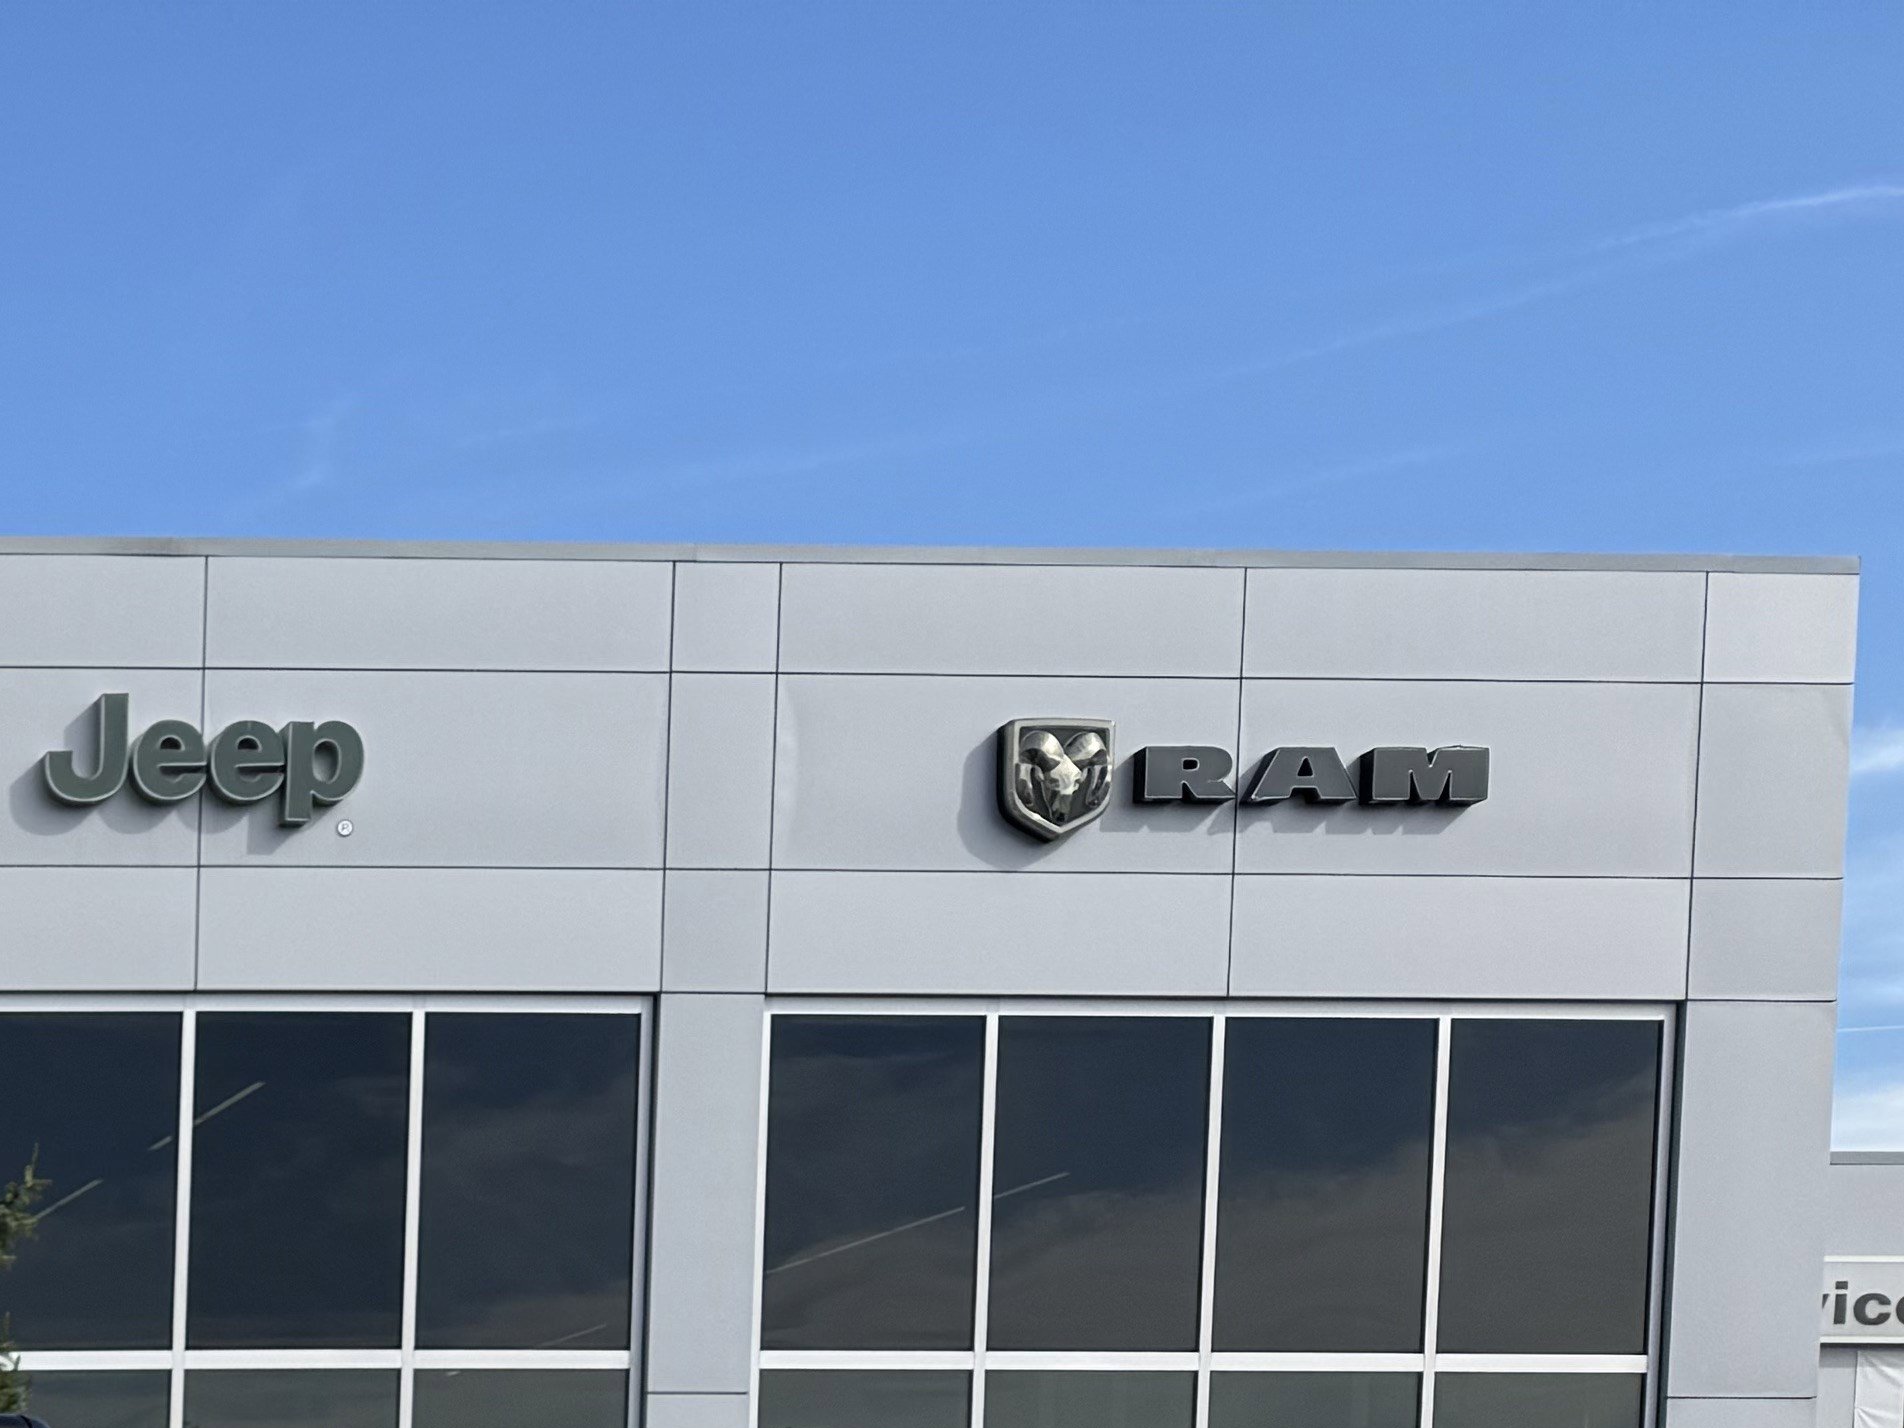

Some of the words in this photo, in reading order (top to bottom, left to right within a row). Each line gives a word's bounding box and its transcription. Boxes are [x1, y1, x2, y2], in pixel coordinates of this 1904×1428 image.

[43, 693, 365, 828] Jeep
[1133, 745, 1490, 806] RAM
[1822, 1281, 1904, 1325] ic
